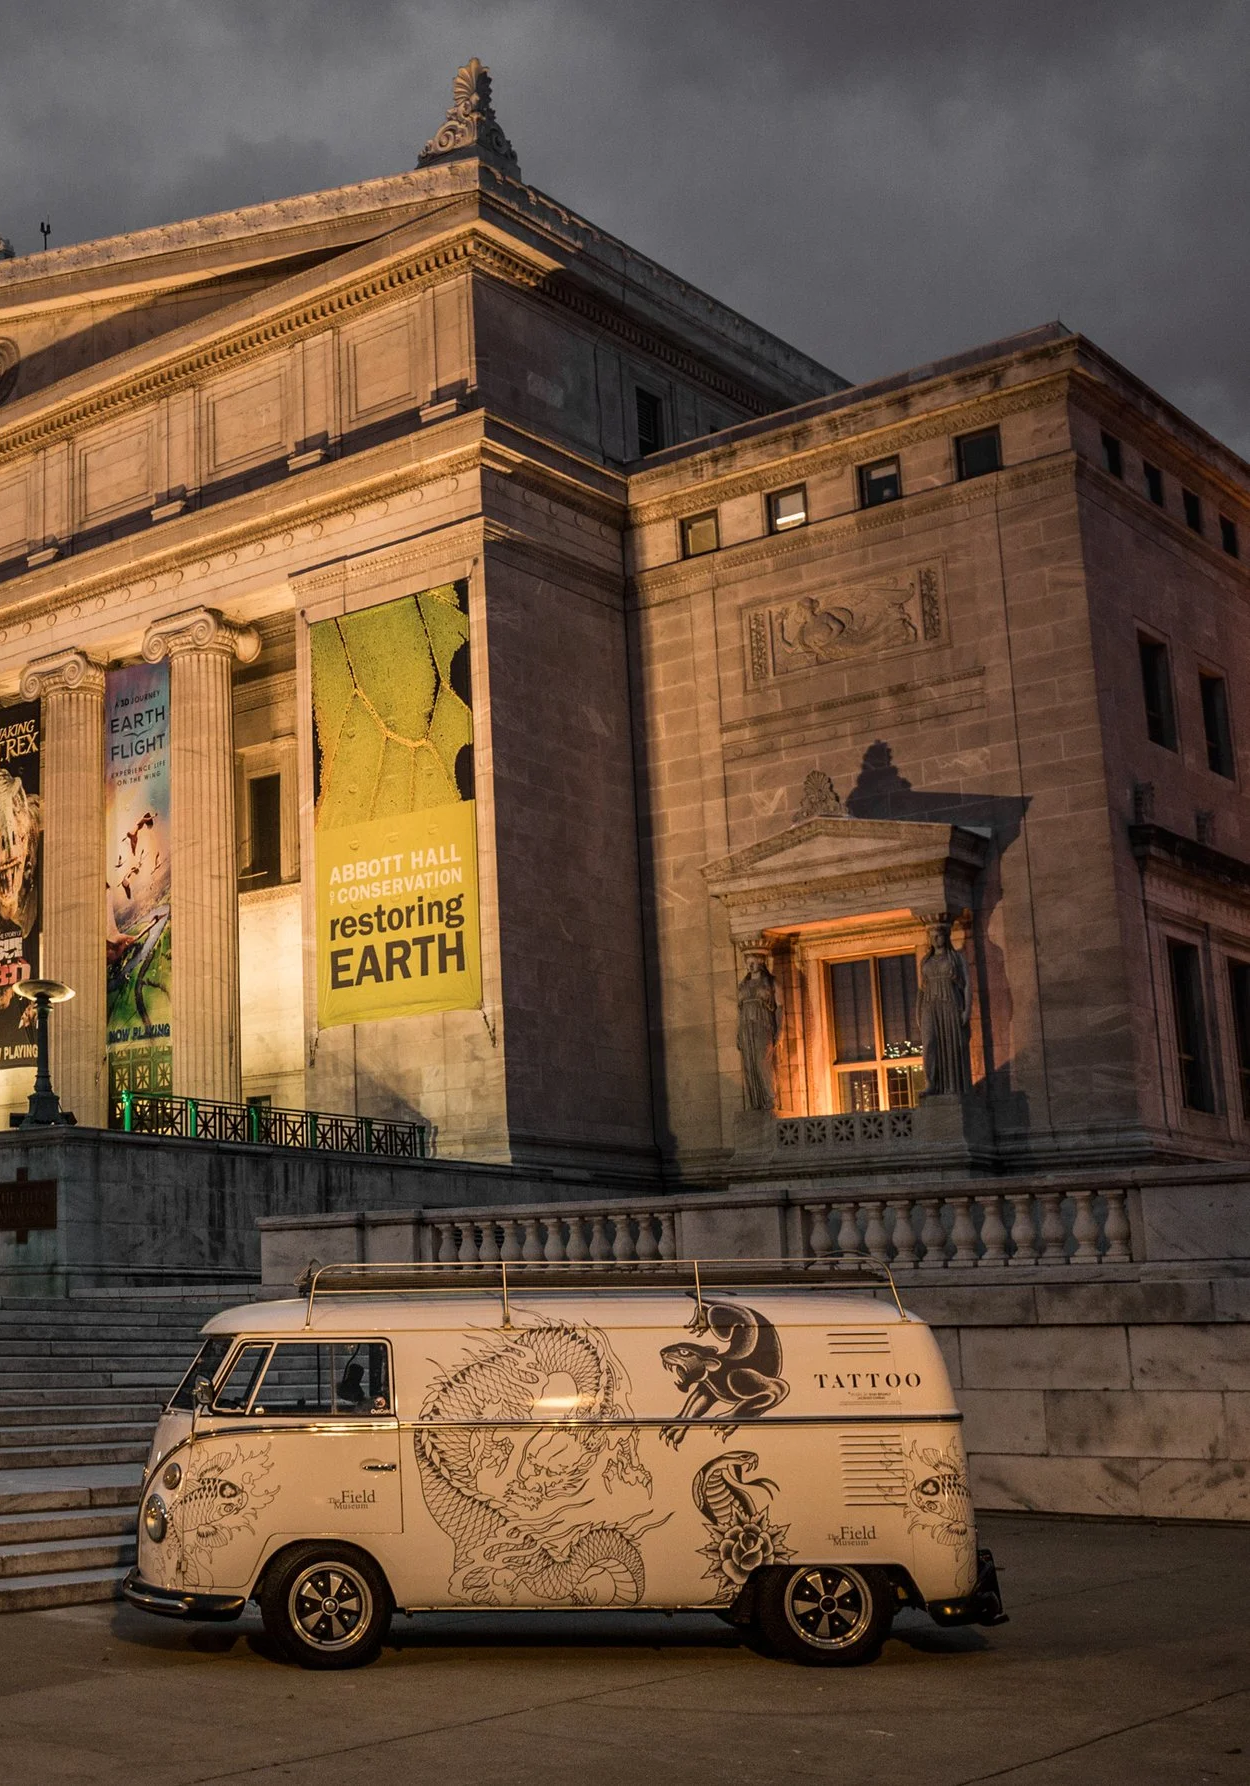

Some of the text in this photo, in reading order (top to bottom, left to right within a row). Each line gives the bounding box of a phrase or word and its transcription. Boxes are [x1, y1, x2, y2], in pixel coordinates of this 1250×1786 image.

[120, 698, 130, 708] 3D
[130, 690, 160, 704] JOURNEY
[110, 706, 165, 734] EARTH
[111, 733, 166, 761] FLIGHT
[111, 760, 166, 779] EXPERIENCE LIFE
[130, 776, 140, 784] THE
[144, 770, 161, 780] WING
[329, 844, 462, 886] ABBOTT HALL
[337, 866, 462, 904] CONSERVATION
[330, 893, 465, 941] restoring
[330, 930, 466, 990] EARTH
[108, 1023, 170, 1045] NOW PLAYING
[4, 1044, 38, 1060] PLAYING
[814, 1372, 921, 1388] TATTOO
[341, 1489, 376, 1504] Field
[334, 1502, 368, 1510] Museum
[833, 1538, 869, 1546] Museum
[840, 1526, 877, 1540] Field
